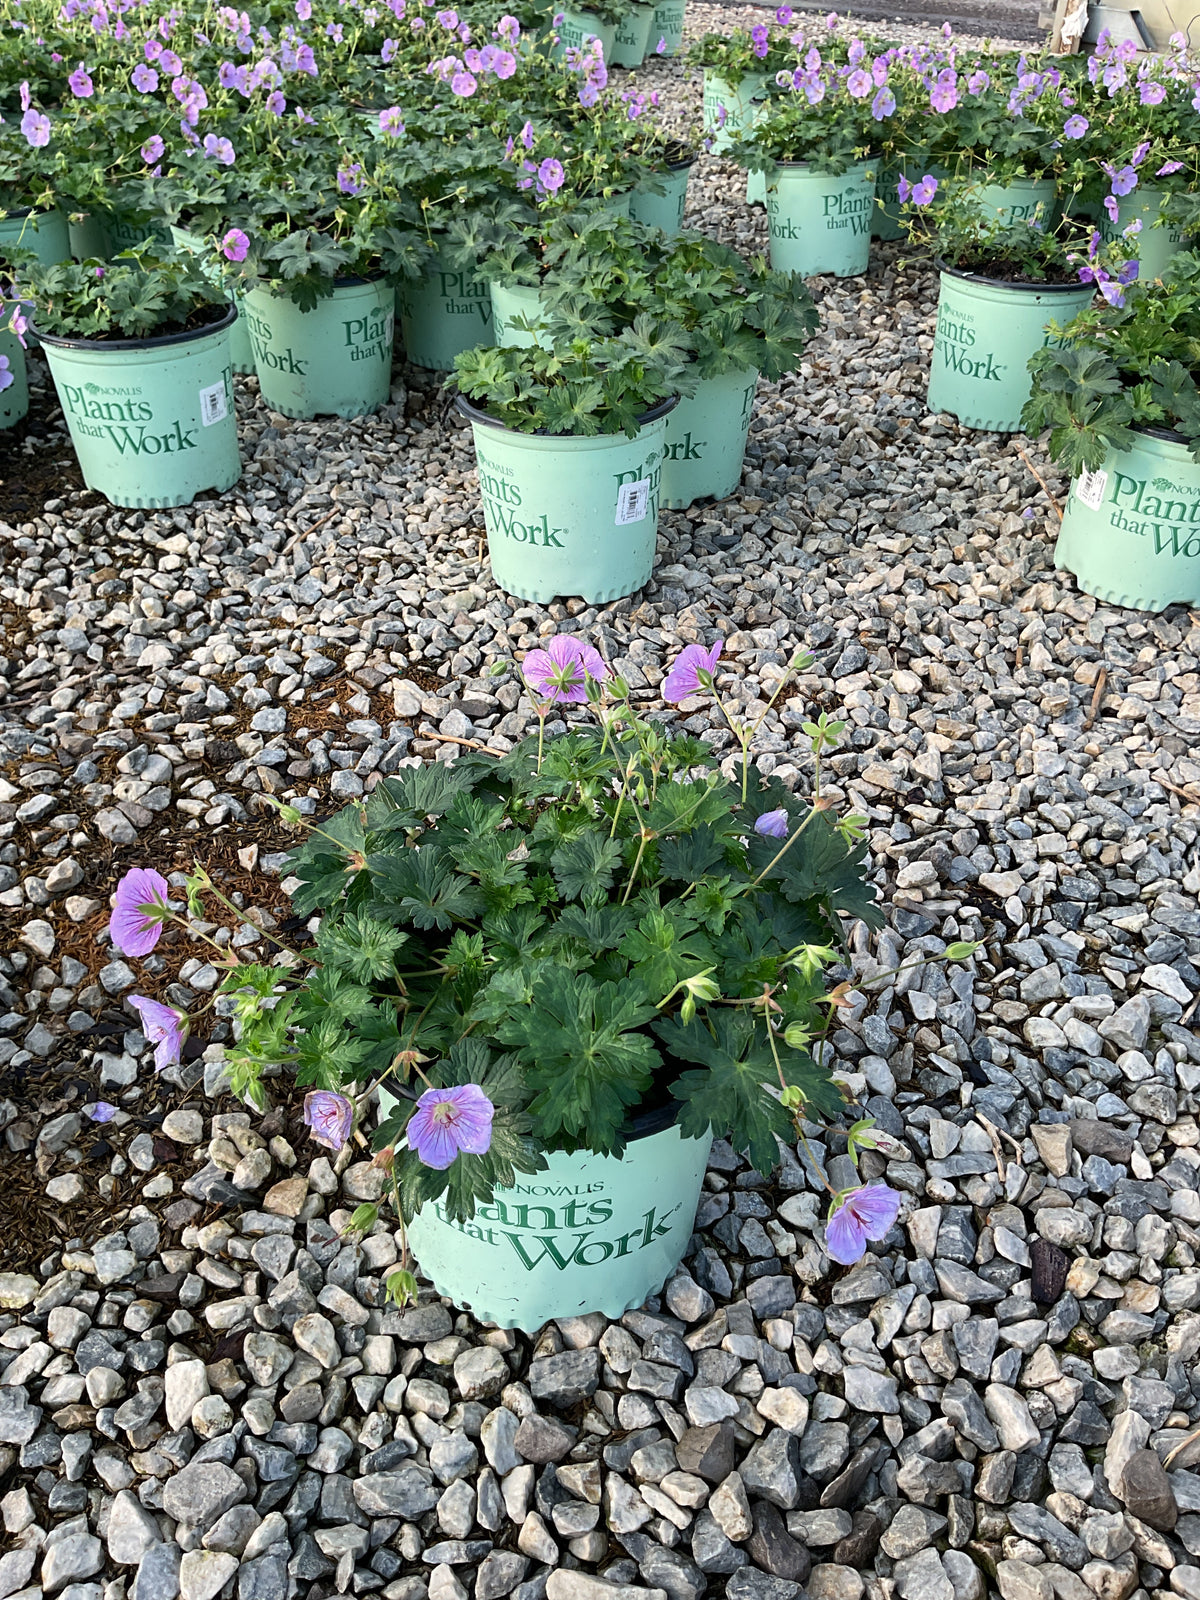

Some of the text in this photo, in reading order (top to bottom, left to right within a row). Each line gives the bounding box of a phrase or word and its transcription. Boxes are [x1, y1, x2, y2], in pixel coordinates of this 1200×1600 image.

[557, 22, 583, 39] Plant
[826, 213, 871, 236] that Wo
[438, 271, 491, 298] Pla
[445, 298, 475, 314] that
[249, 315, 273, 341] nts
[341, 315, 386, 347] Pla
[938, 304, 976, 346] lants
[350, 345, 376, 361] that
[942, 340, 1003, 381] Work
[61, 382, 153, 422] Plants
[101, 386, 142, 395] NOVALIS
[76, 417, 198, 455] that Work
[662, 431, 702, 460] ork
[480, 468, 522, 506] ants
[1109, 470, 1200, 523] Plant
[1170, 484, 1200, 496] NOVA
[486, 497, 566, 548] Work
[1110, 509, 1200, 558] that Wo
[516, 1181, 604, 1196] NOVALIS
[475, 1198, 614, 1230] ants
[432, 1202, 674, 1272] tat Work
